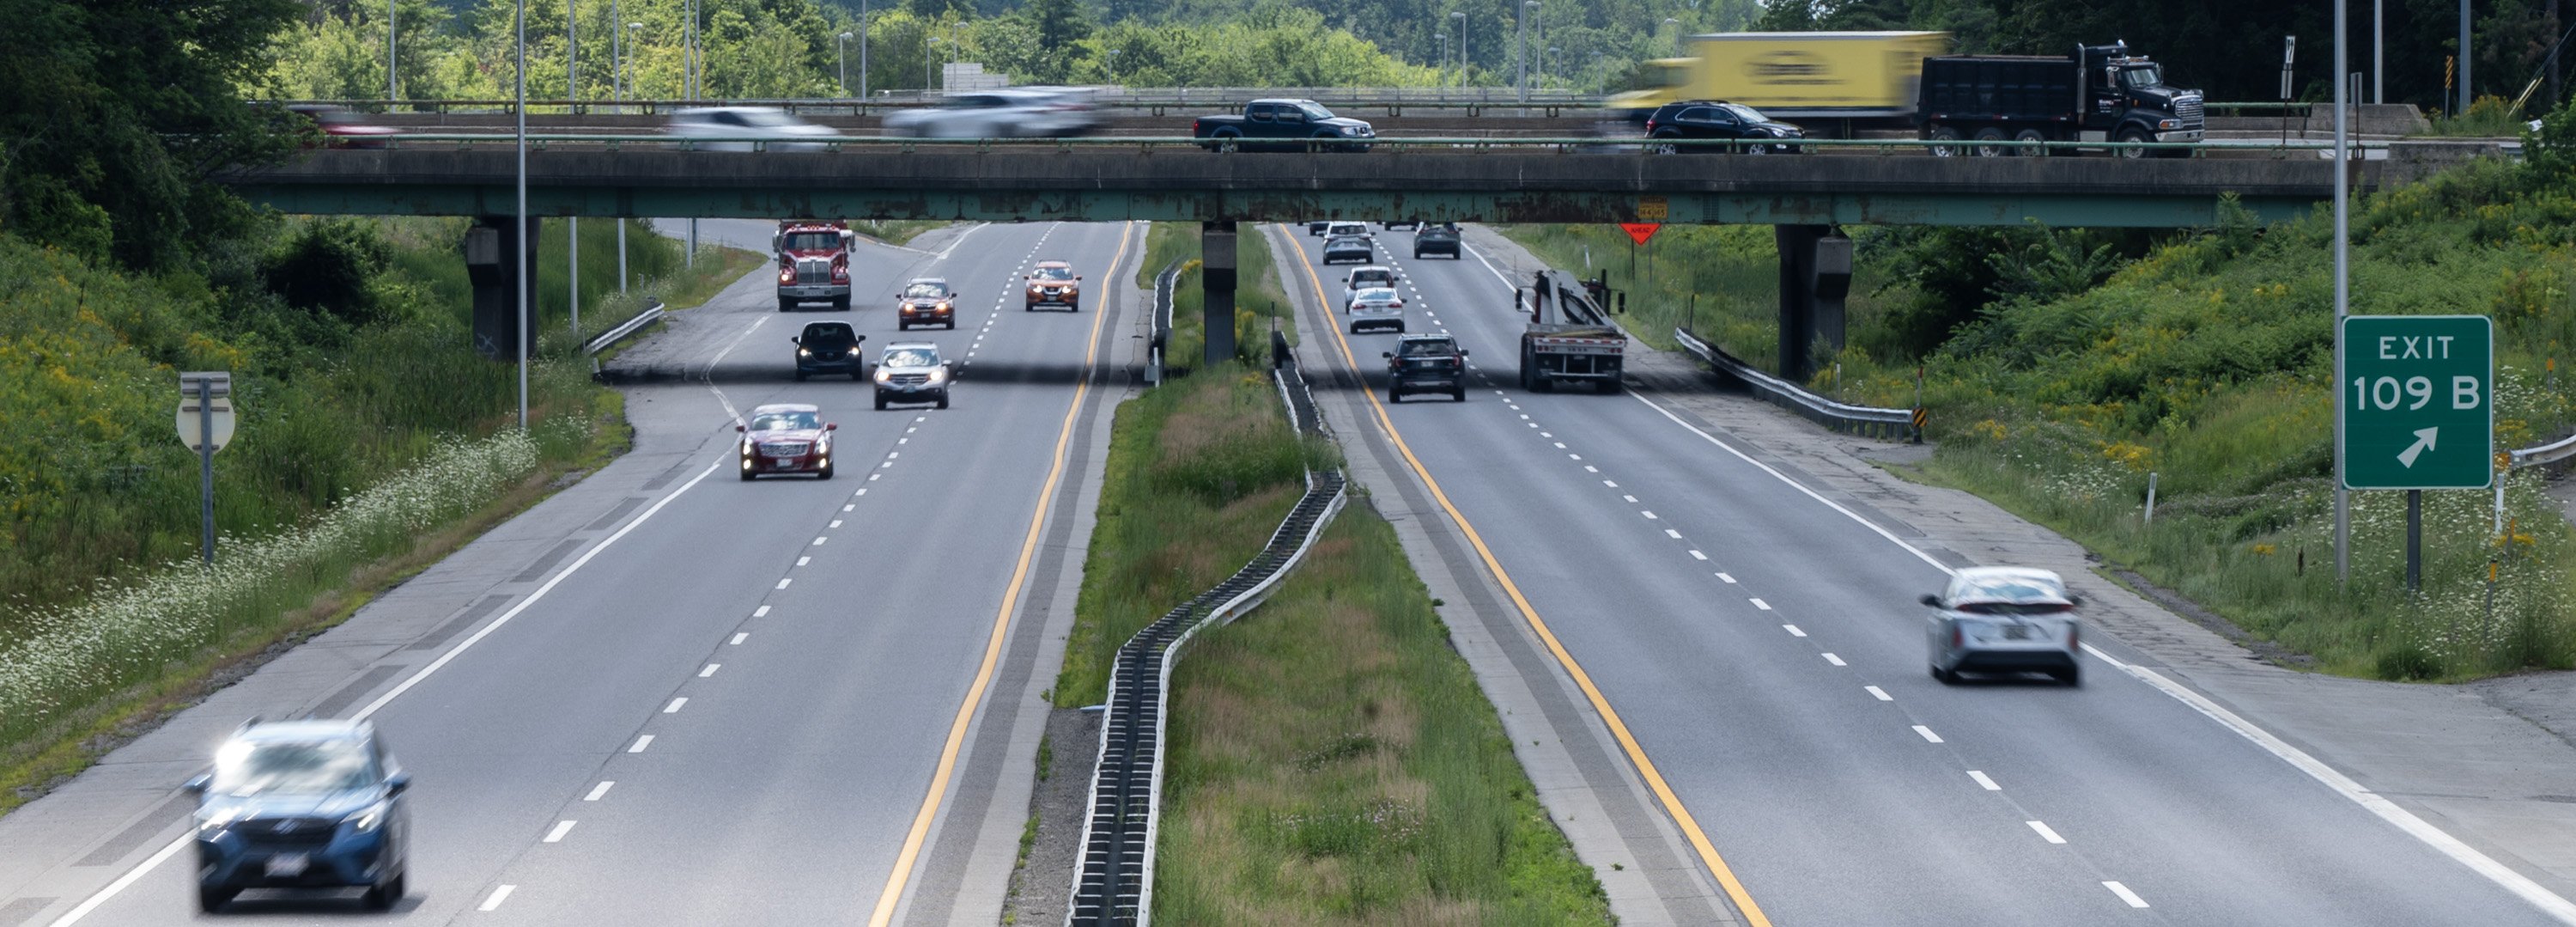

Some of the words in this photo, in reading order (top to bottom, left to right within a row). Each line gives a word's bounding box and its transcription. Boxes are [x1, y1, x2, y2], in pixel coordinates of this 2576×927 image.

[2379, 336, 2454, 359] EXIT
[2354, 375, 2433, 411] 109
[2452, 375, 2481, 410] B
